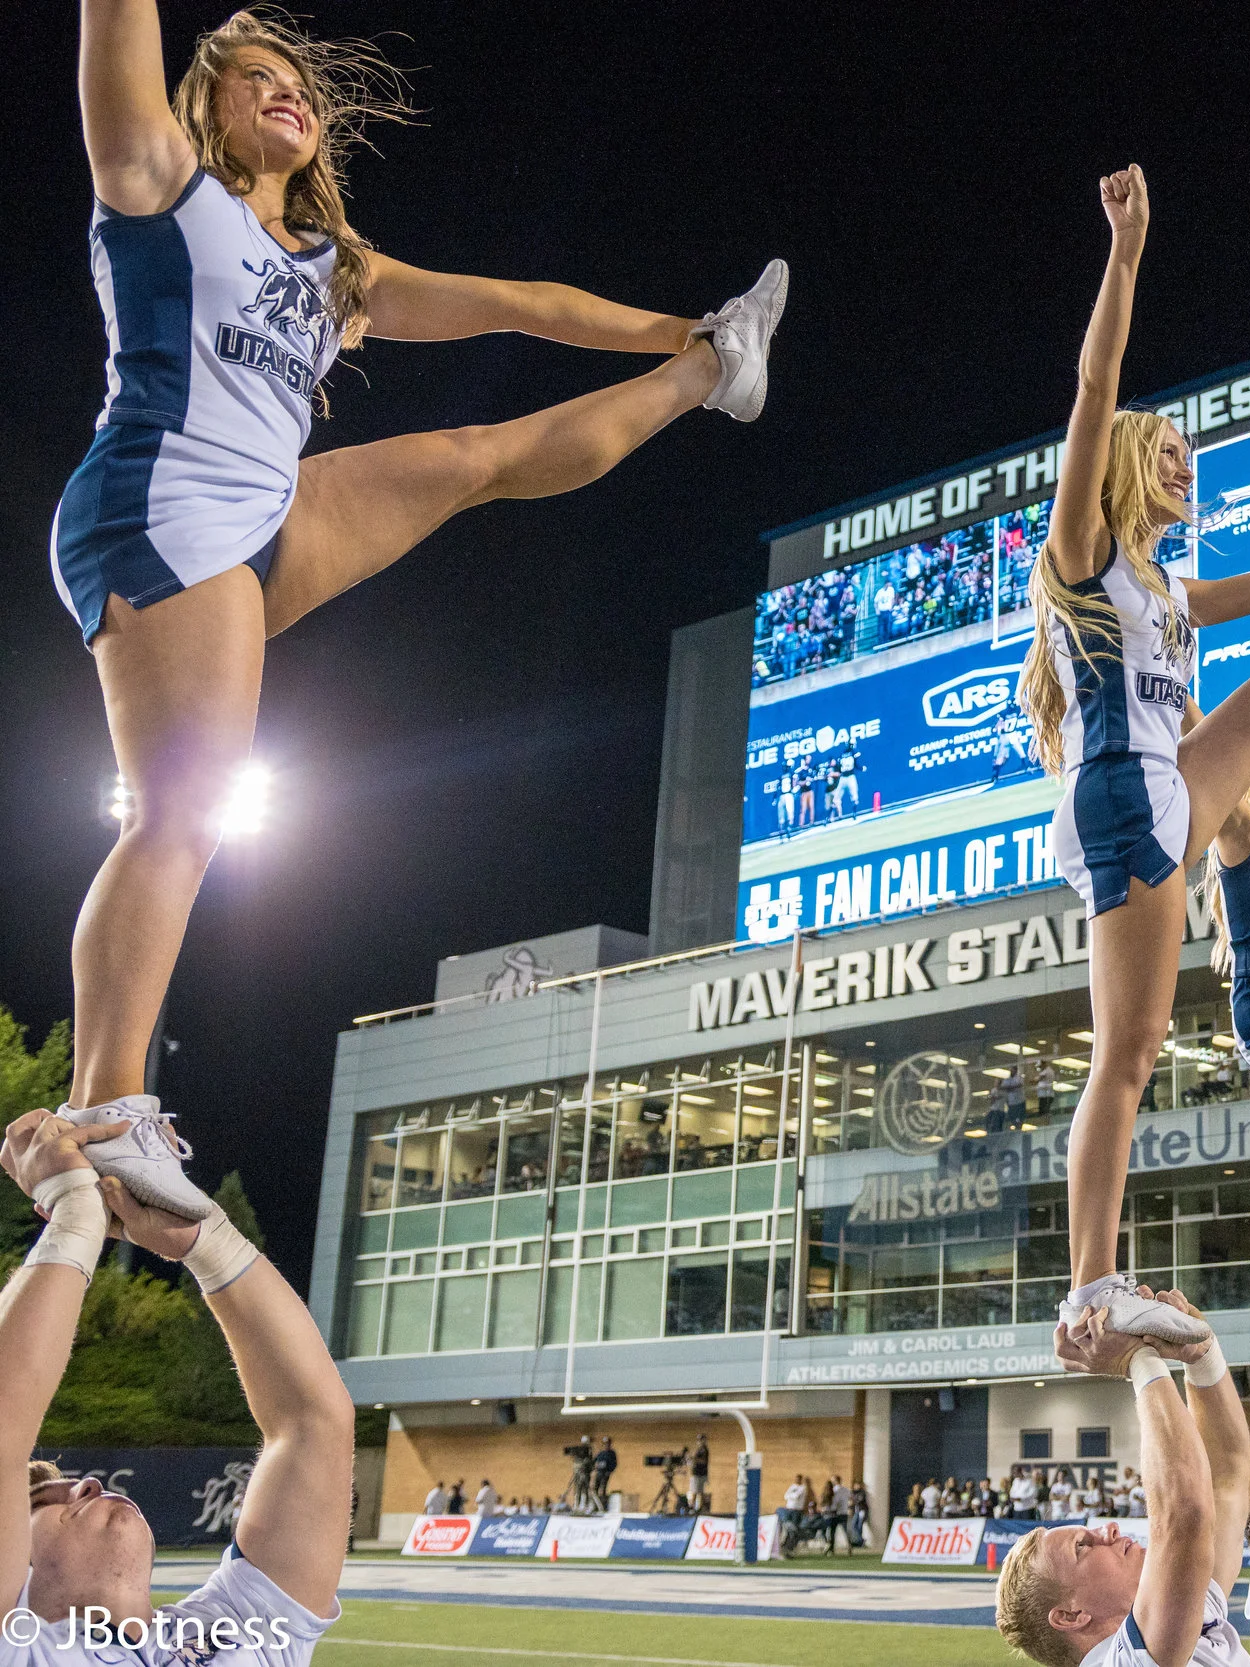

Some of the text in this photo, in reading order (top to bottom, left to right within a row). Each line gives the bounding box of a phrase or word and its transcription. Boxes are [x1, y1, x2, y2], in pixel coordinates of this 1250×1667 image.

[823, 488, 937, 559] HOME
[941, 467, 995, 518] OF
[938, 678, 1010, 718] ARS
[909, 738, 948, 757] CLEANUP
[815, 863, 873, 929] FAN
[880, 847, 956, 915] CALL
[964, 834, 1006, 897] OF
[744, 894, 804, 928] STATE
[688, 942, 934, 1032] MAVERIK
[847, 1164, 1000, 1222] Allstate
[848, 1331, 1016, 1357] JIM & CAROL LAUB
[993, 1353, 1062, 1372] COMPL
[892, 1519, 975, 1555] Smith's
